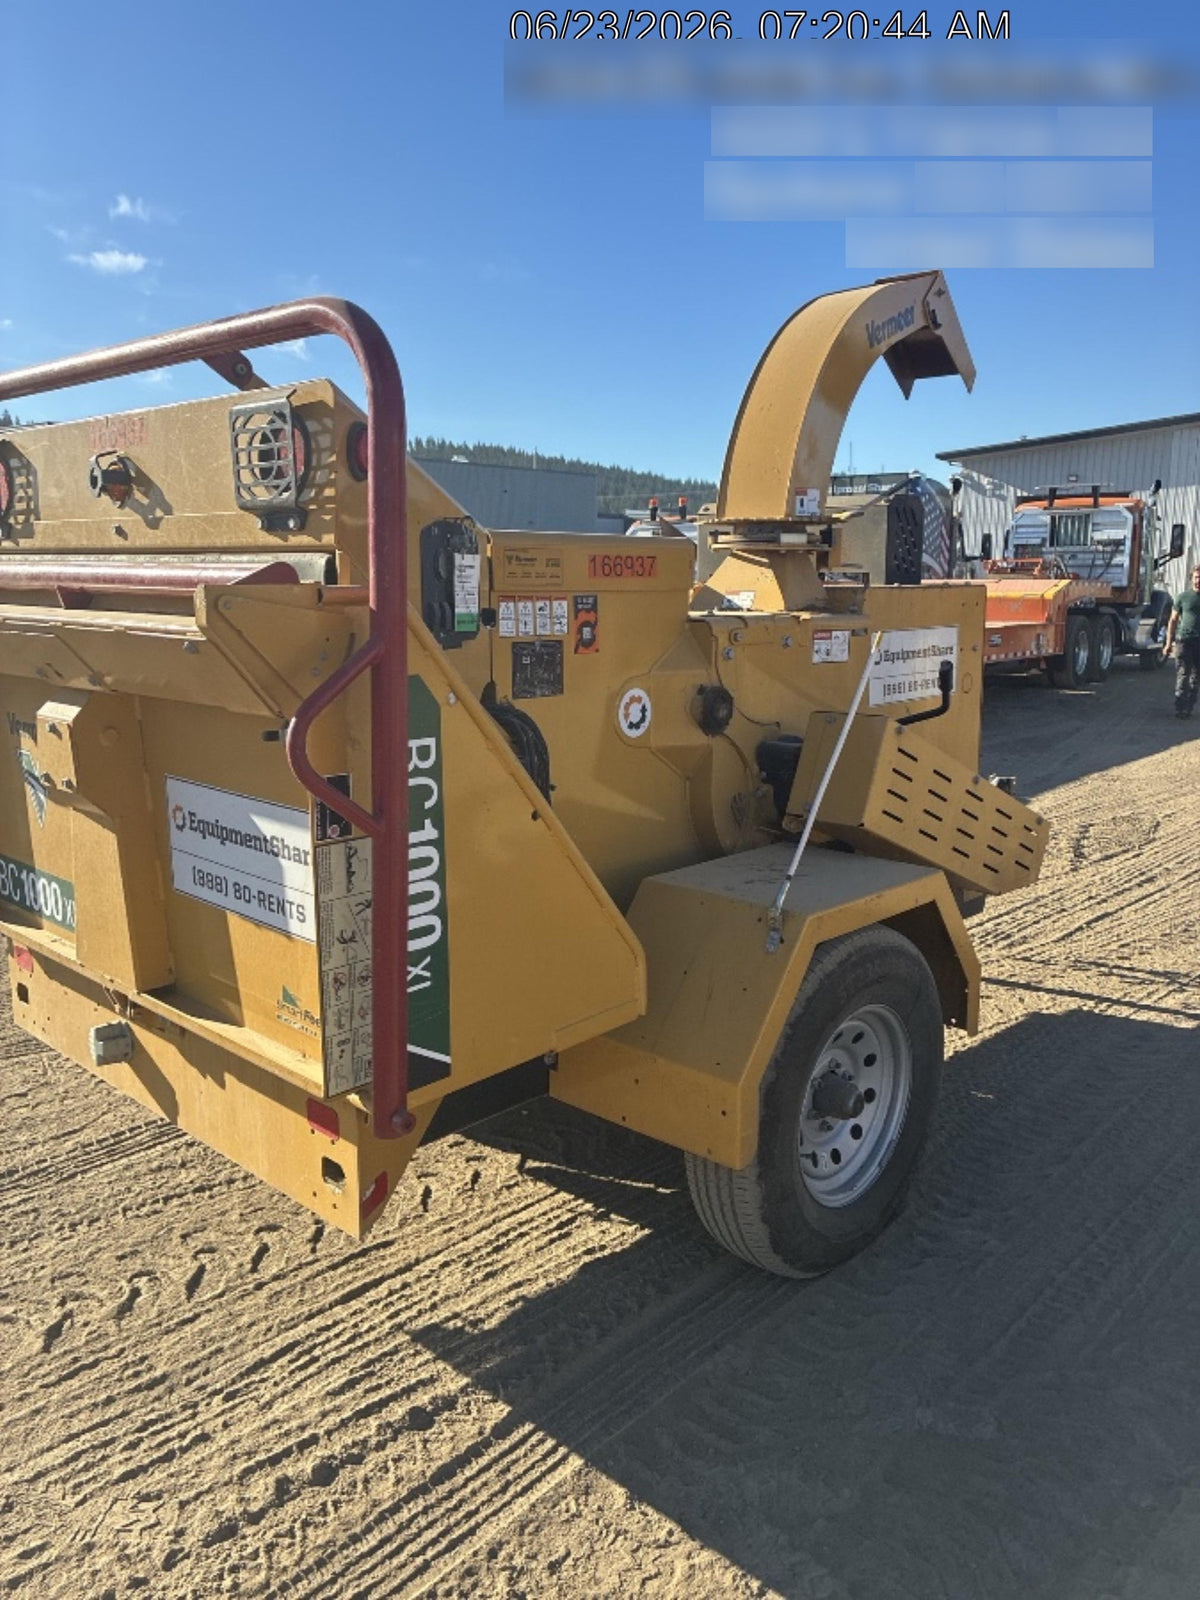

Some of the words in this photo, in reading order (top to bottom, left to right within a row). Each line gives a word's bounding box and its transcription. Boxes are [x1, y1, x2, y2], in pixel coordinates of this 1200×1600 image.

[865, 305, 915, 349] Vermeer
[590, 555, 657, 577] 166937
[883, 643, 954, 665] EquipmentShare
[191, 865, 229, 897] (888)
[232, 881, 307, 924] 80-RENTS
